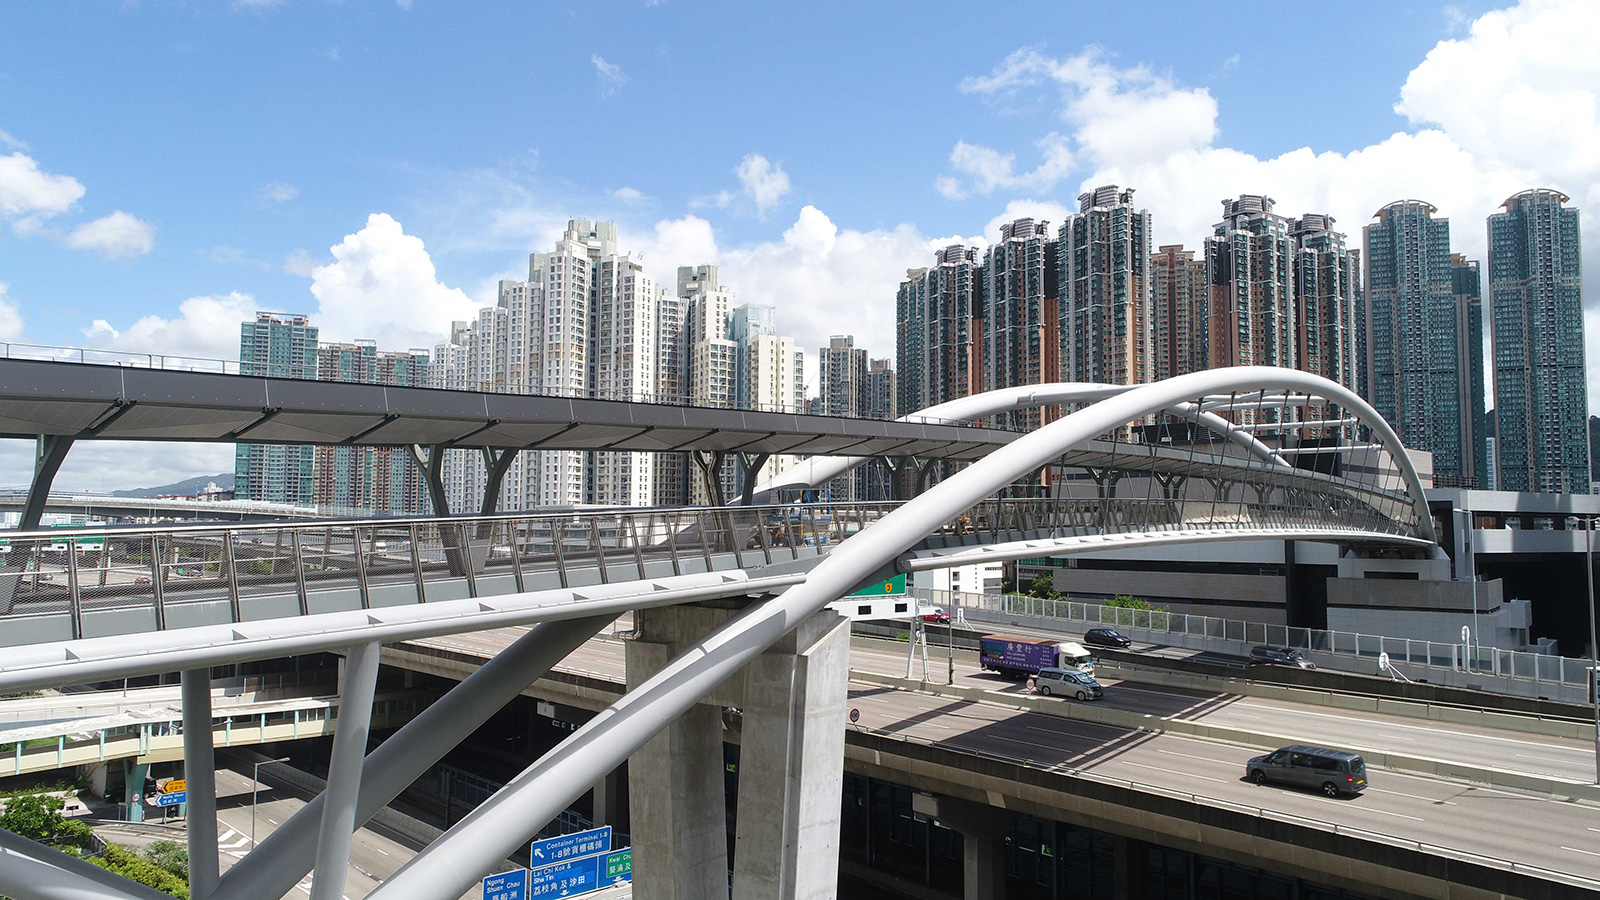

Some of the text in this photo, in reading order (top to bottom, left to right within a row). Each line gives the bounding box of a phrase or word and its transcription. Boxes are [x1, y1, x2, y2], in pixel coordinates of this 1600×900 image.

[546, 839, 574, 850] Container
[575, 833, 599, 843] Terminal
[609, 855, 620, 863] Kwai
[543, 867, 554, 875] Chi
[554, 864, 566, 872] Kok
[486, 878, 504, 887] Ngong
[533, 876, 545, 884] Sha
[486, 881, 521, 894] Shuen Chau
